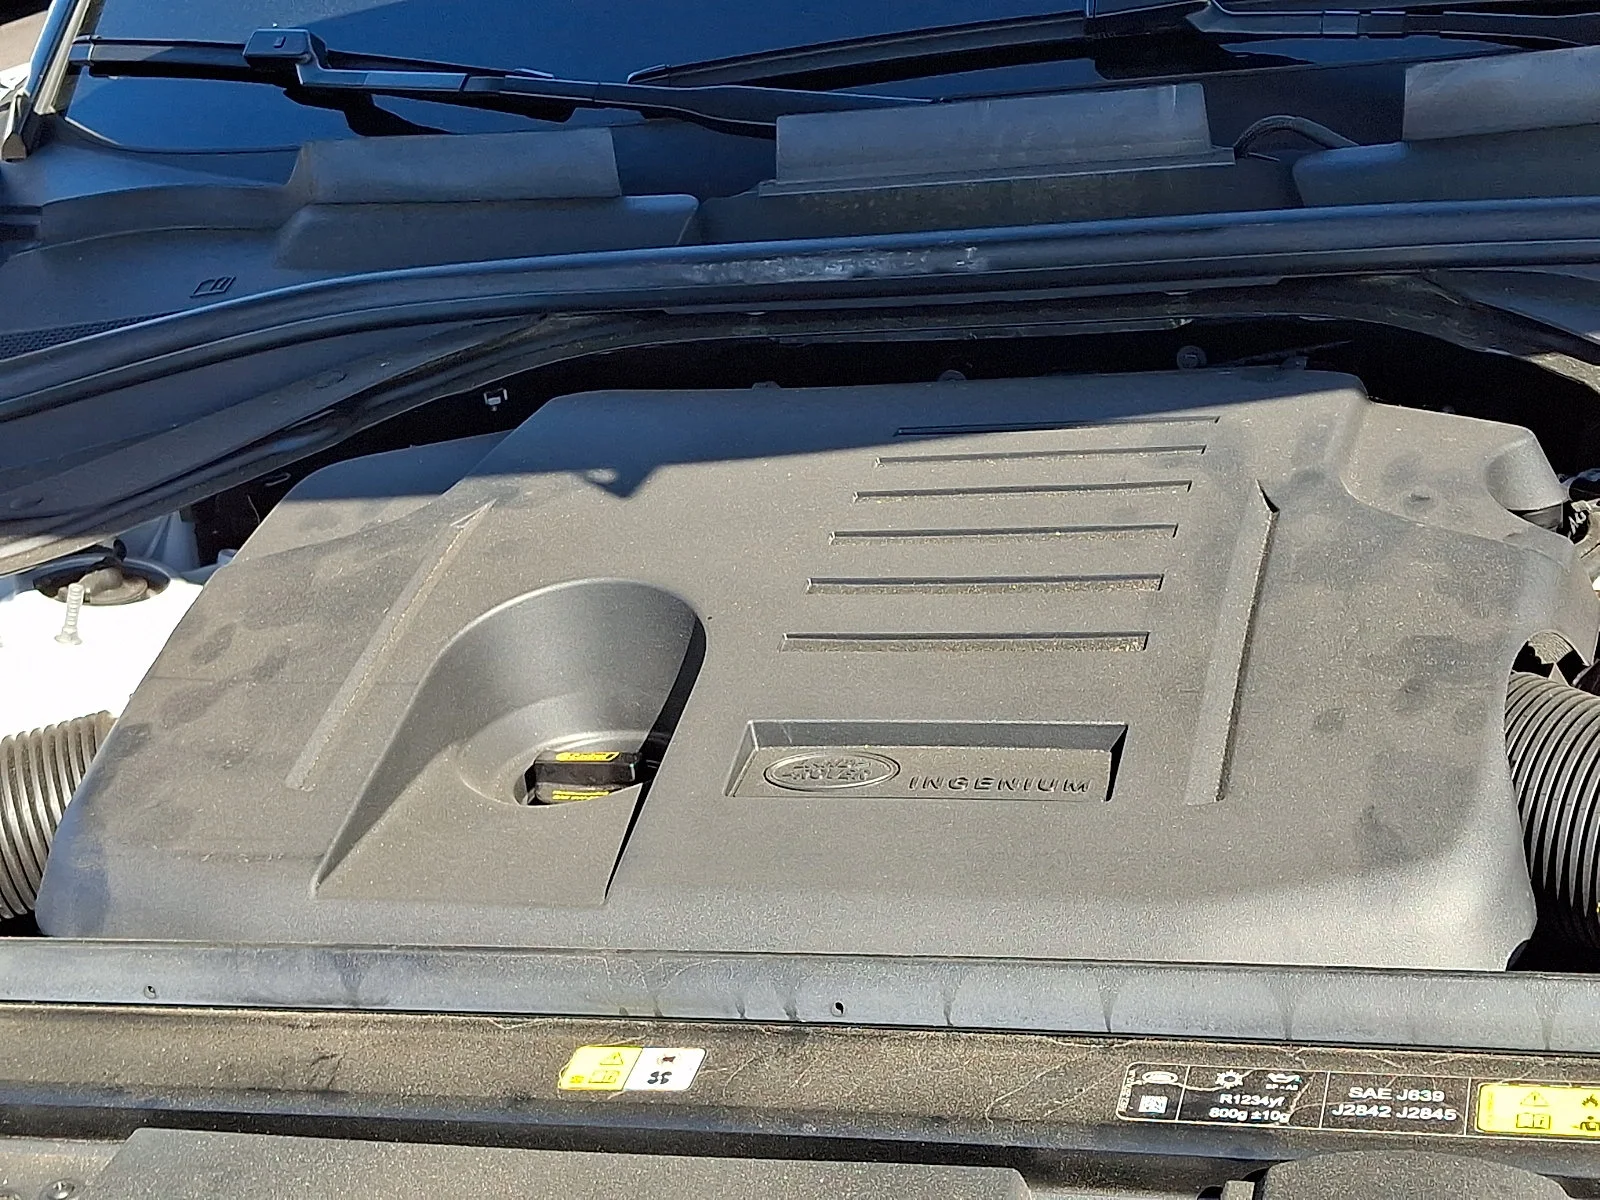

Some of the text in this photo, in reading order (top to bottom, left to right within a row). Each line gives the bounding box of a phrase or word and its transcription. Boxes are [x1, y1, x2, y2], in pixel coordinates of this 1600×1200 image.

[908, 775, 1091, 793] INGENIUM
[1219, 1093, 1286, 1108] R1234yf
[1348, 1086, 1445, 1103] SAE J639
[1208, 1107, 1249, 1122] 800g
[1331, 1103, 1457, 1121] J2842 J2845
